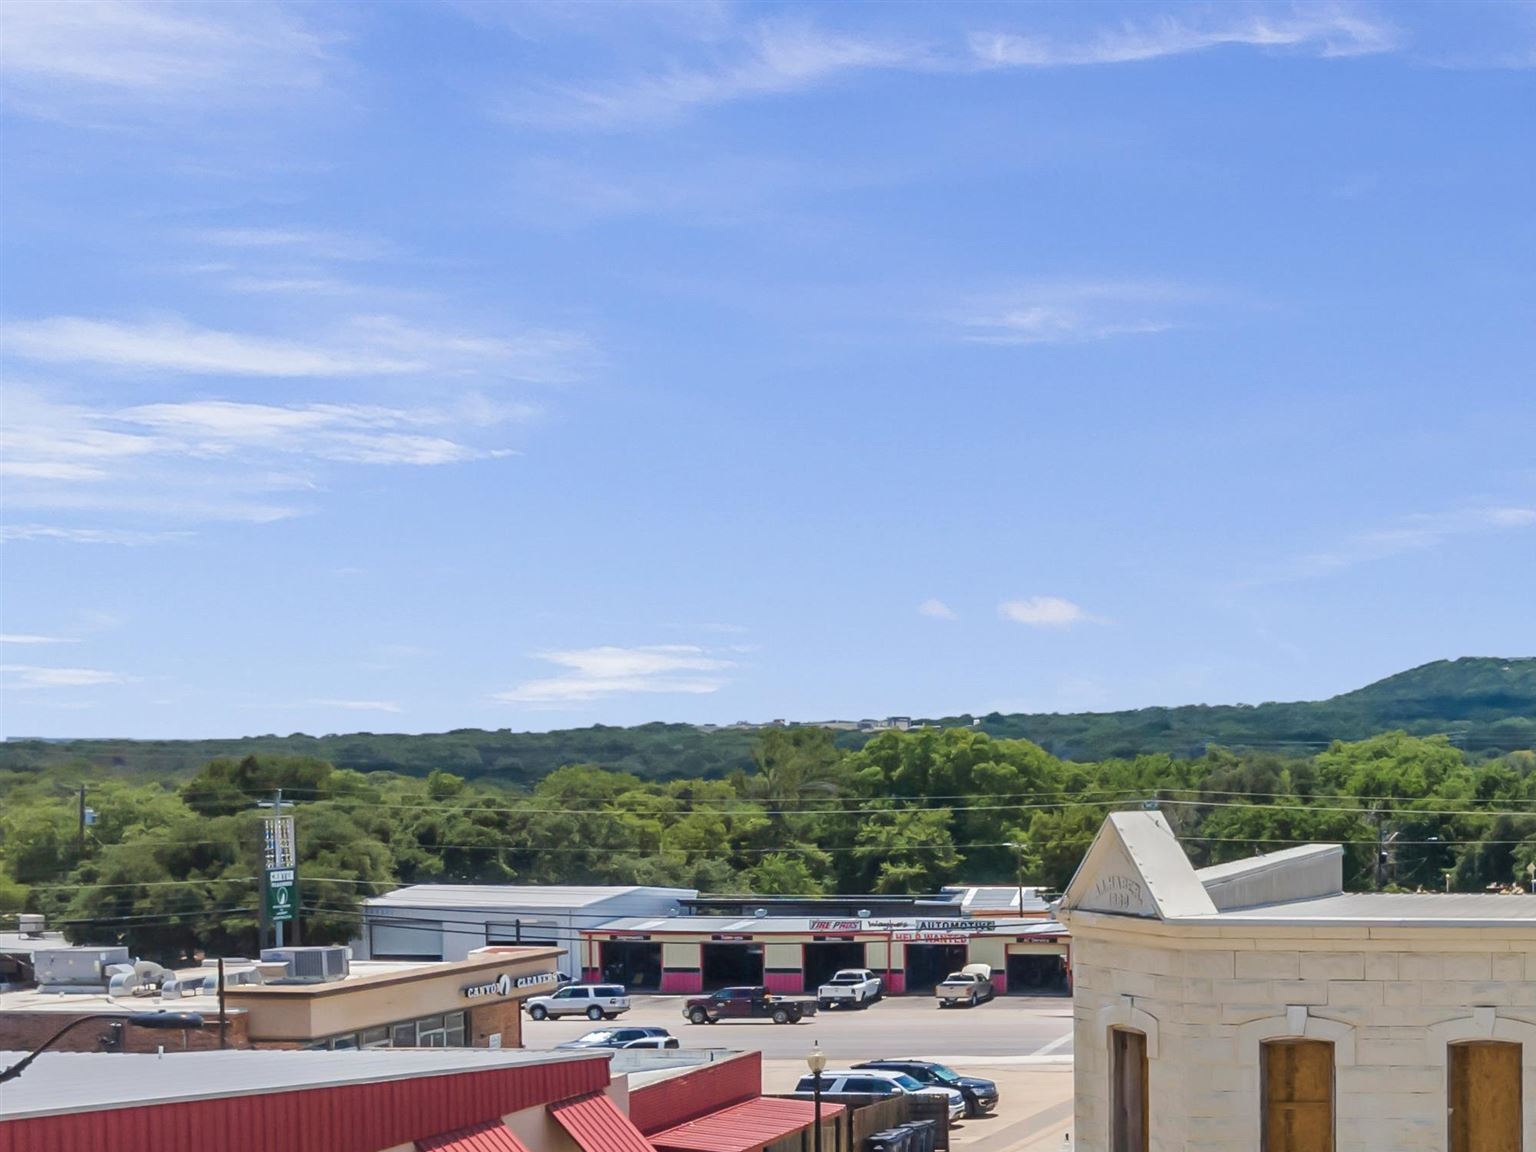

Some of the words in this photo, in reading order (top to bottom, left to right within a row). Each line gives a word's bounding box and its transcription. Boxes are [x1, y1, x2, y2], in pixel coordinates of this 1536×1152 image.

[811, 921, 831, 930] TIRE
[920, 920, 995, 931] AUTOMOTIVE
[926, 933, 968, 944] WANTED
